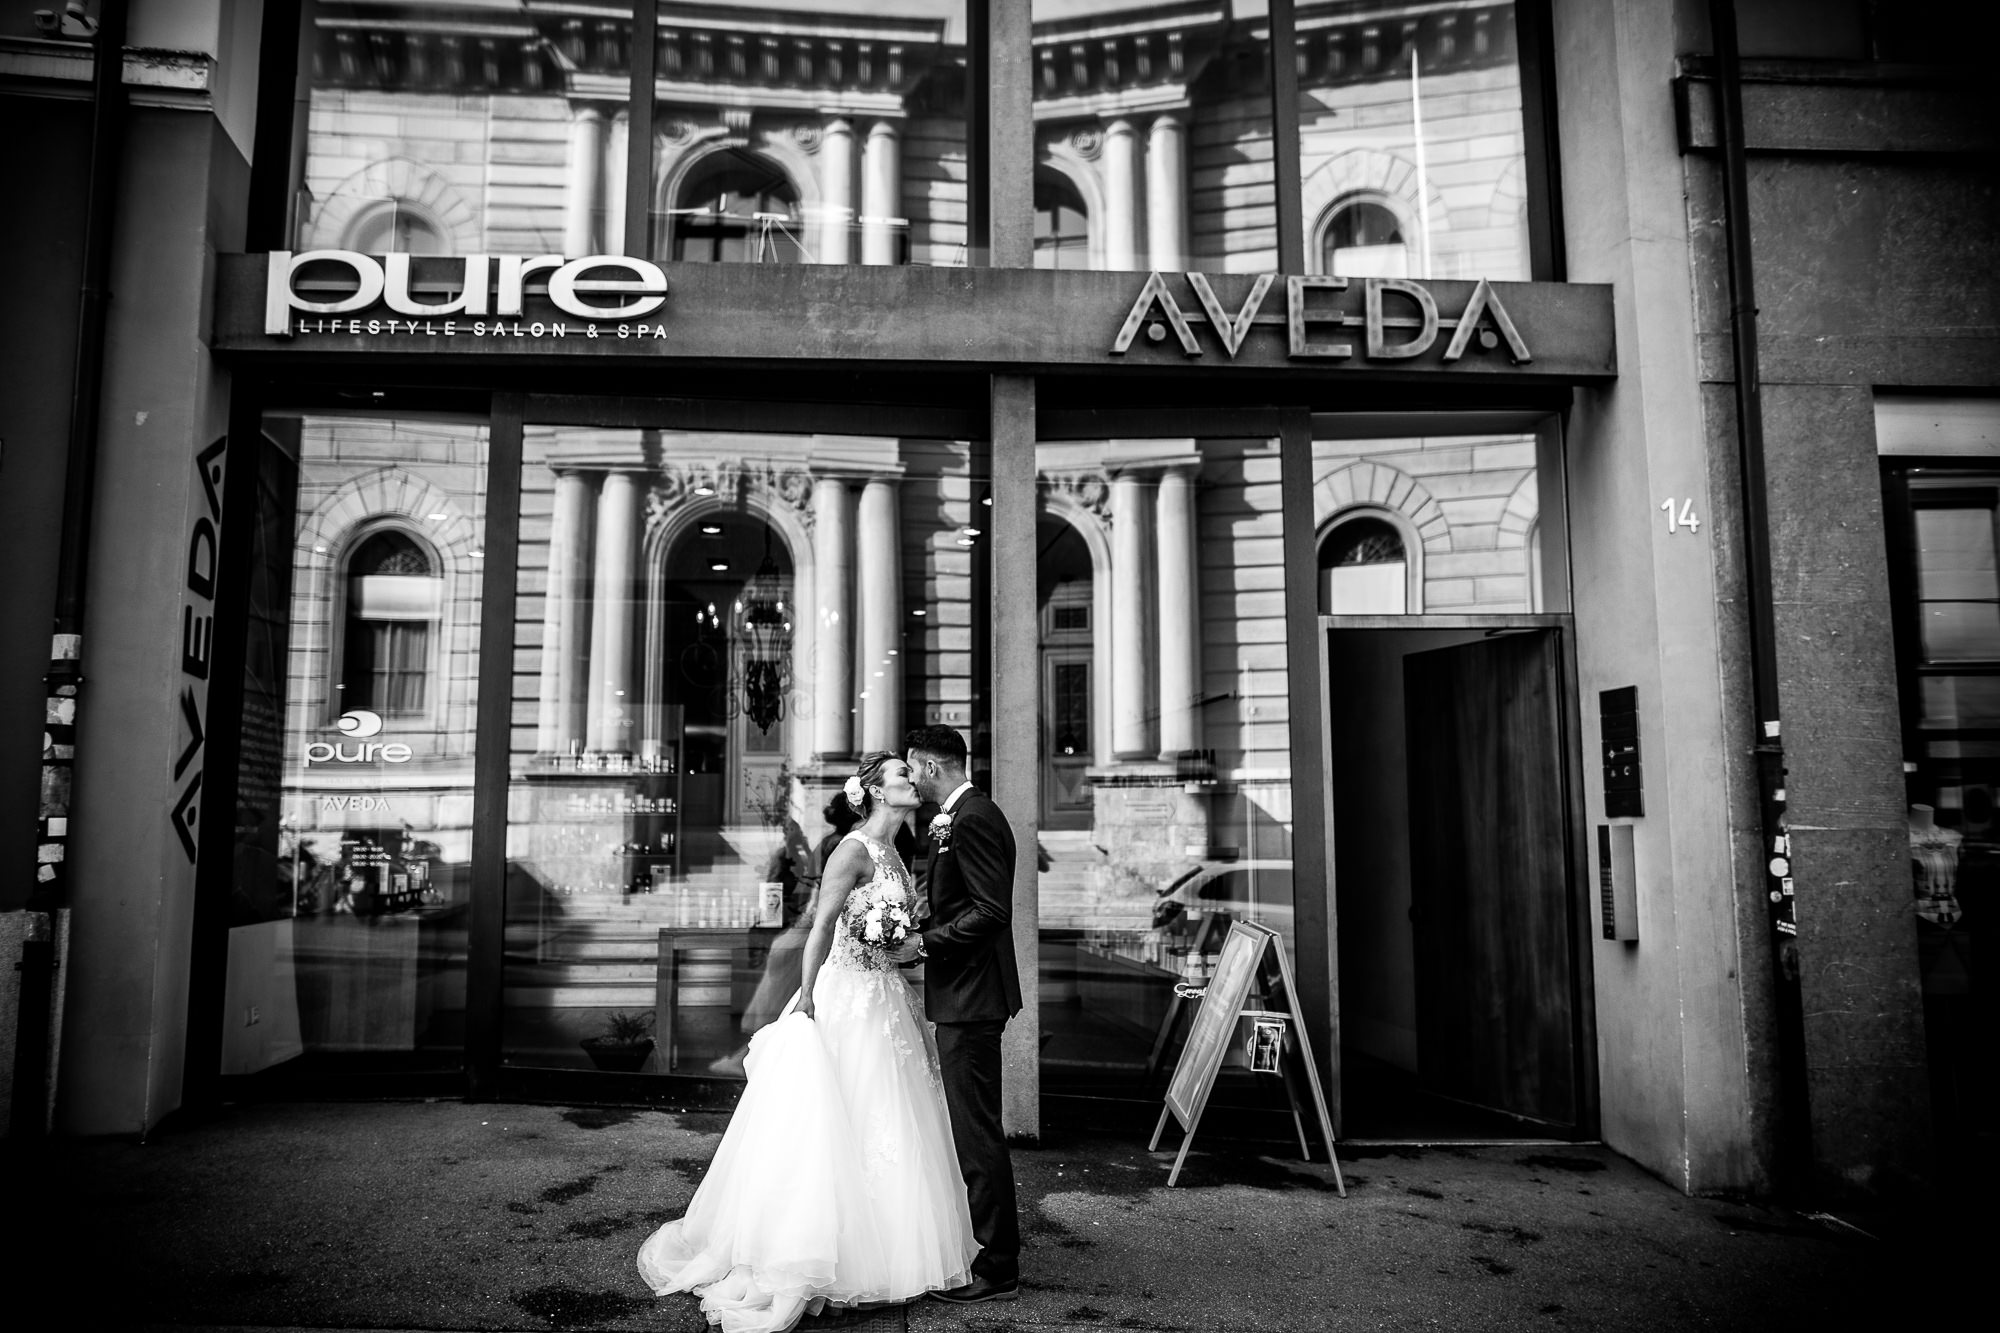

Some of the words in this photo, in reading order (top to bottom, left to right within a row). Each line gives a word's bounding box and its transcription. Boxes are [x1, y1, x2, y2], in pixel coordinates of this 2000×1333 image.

[265, 250, 668, 336] pure
[300, 319, 456, 337] LIFESTYLE
[473, 321, 566, 338] SALON
[586, 323, 599, 339] &
[617, 324, 668, 340] SPA
[1109, 270, 1531, 364] AVEDA
[1661, 498, 1700, 533] 14
[171, 435, 227, 865] AVEDA
[303, 742, 413, 768] pure
[323, 796, 391, 811] AVEDA
